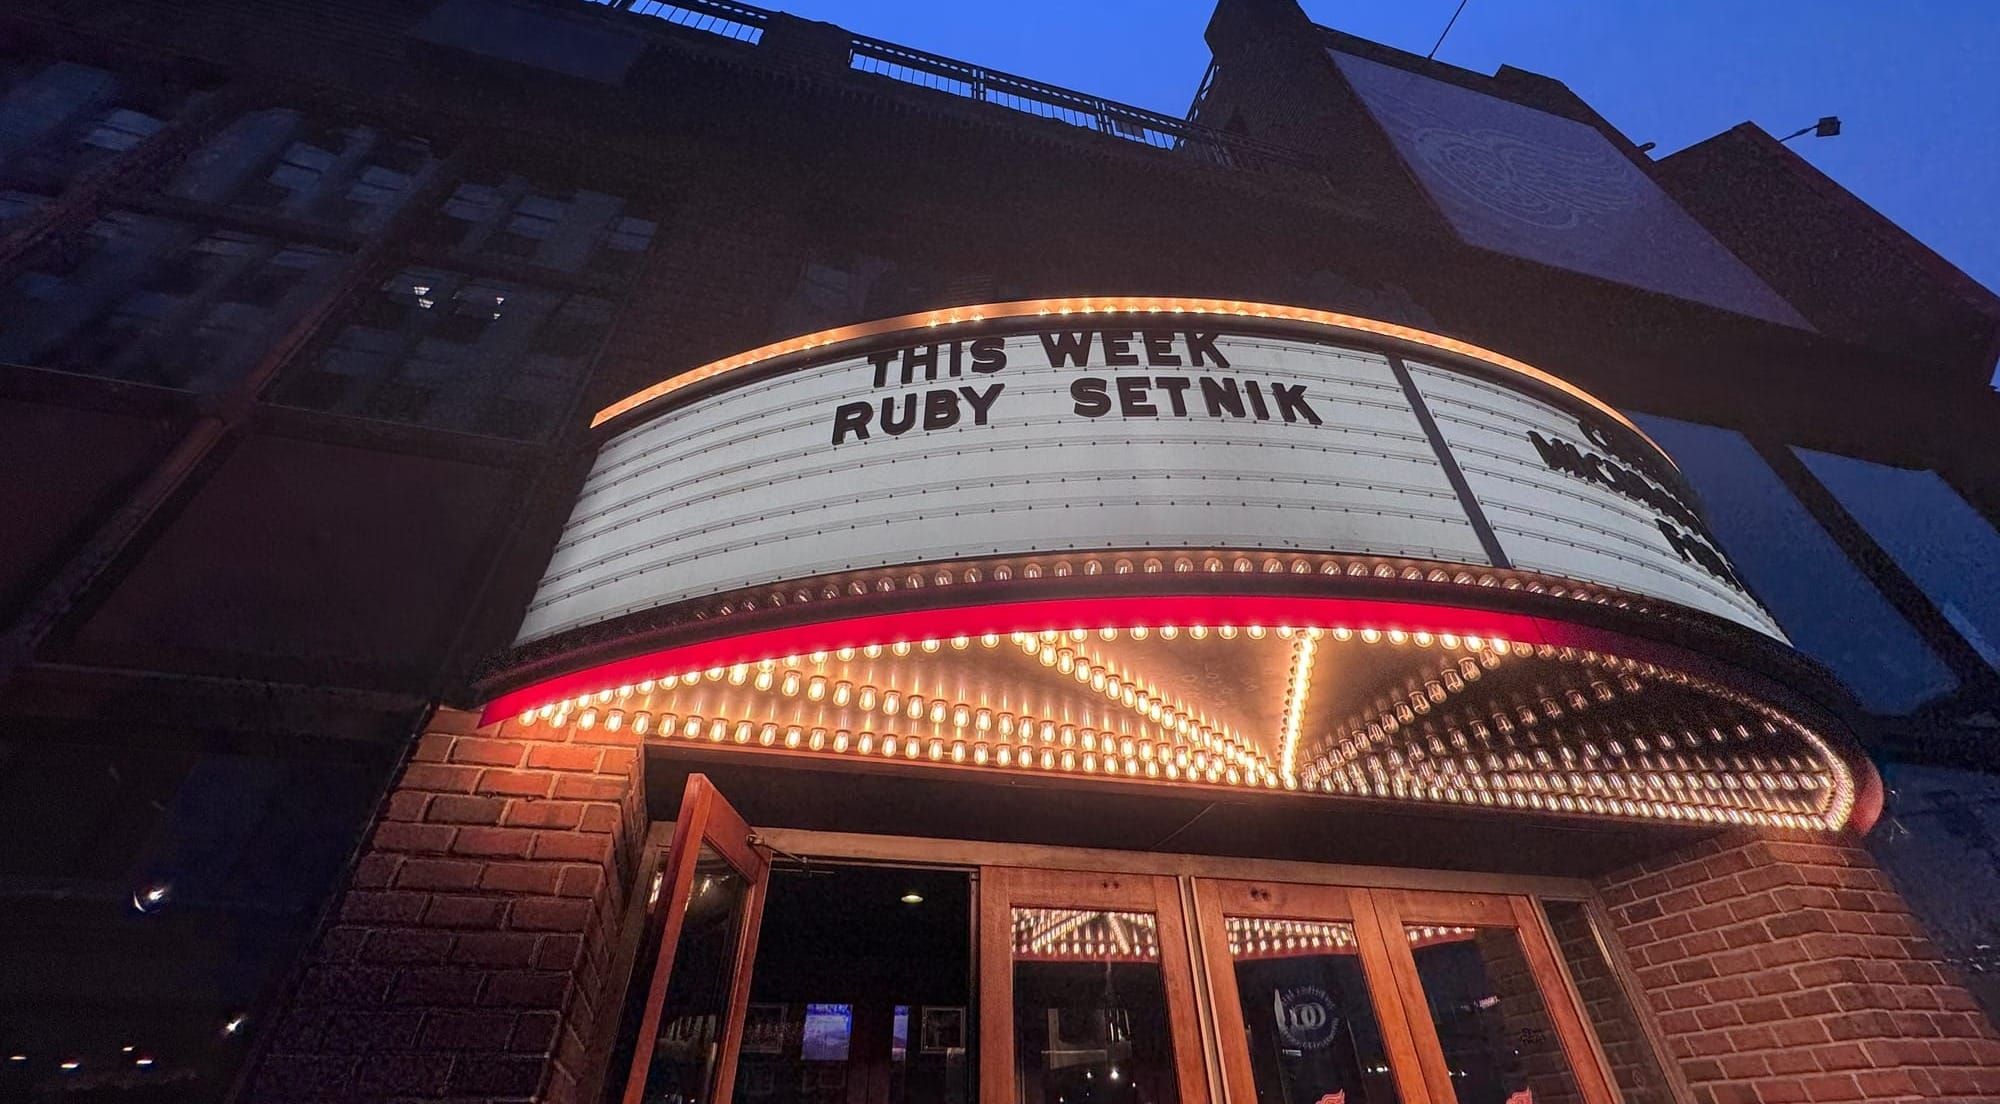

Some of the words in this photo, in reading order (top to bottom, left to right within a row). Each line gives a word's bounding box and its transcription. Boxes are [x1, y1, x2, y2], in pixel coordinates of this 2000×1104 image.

[867, 336, 1007, 388] THIS
[1038, 330, 1231, 368] WEEK
[832, 383, 1005, 445] RUBY
[1070, 376, 1323, 425] SETNIK
